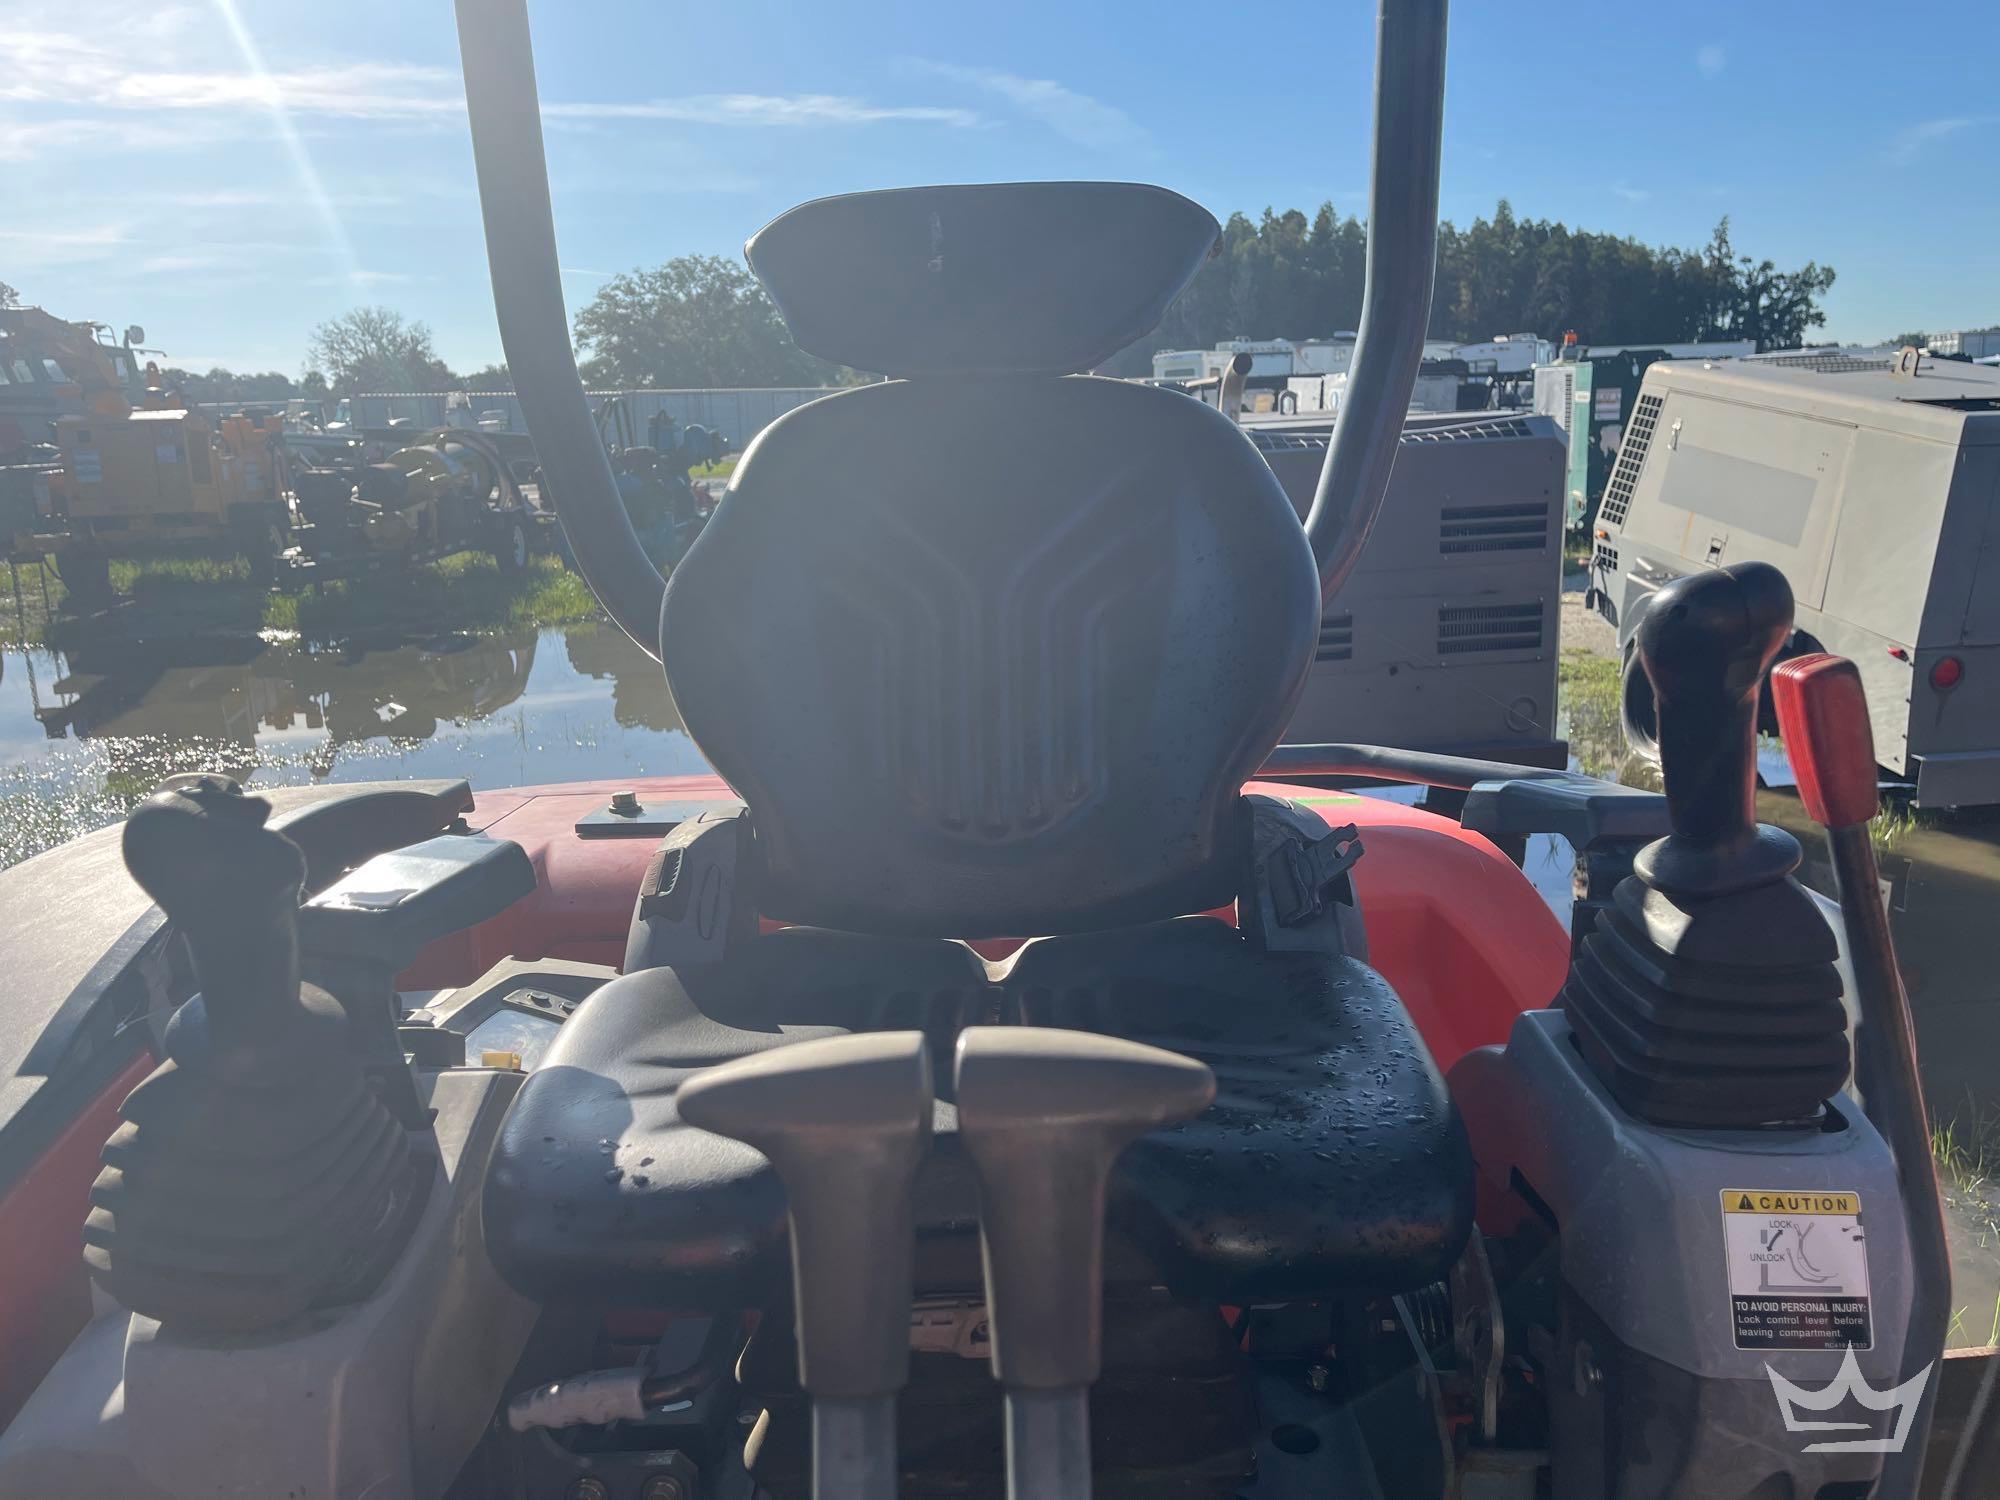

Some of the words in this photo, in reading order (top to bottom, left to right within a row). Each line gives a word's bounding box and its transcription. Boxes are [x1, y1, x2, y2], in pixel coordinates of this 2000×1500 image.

[1760, 1197, 1848, 1211] CAUTION
[1769, 1220, 1793, 1229] LOCK
[1750, 1253, 1785, 1262] UNLOCK
[1735, 1302, 1749, 1311] TO
[1750, 1302, 1779, 1311] AVOID
[1781, 1303, 1830, 1312] PERSONAL
[1832, 1304, 1867, 1313] INJURY:
[1738, 1314, 1761, 1324] Lock
[1766, 1315, 1800, 1325] control
[1805, 1316, 1828, 1325] lever
[1834, 1316, 1863, 1325] before
[1739, 1328, 1773, 1339] leaving
